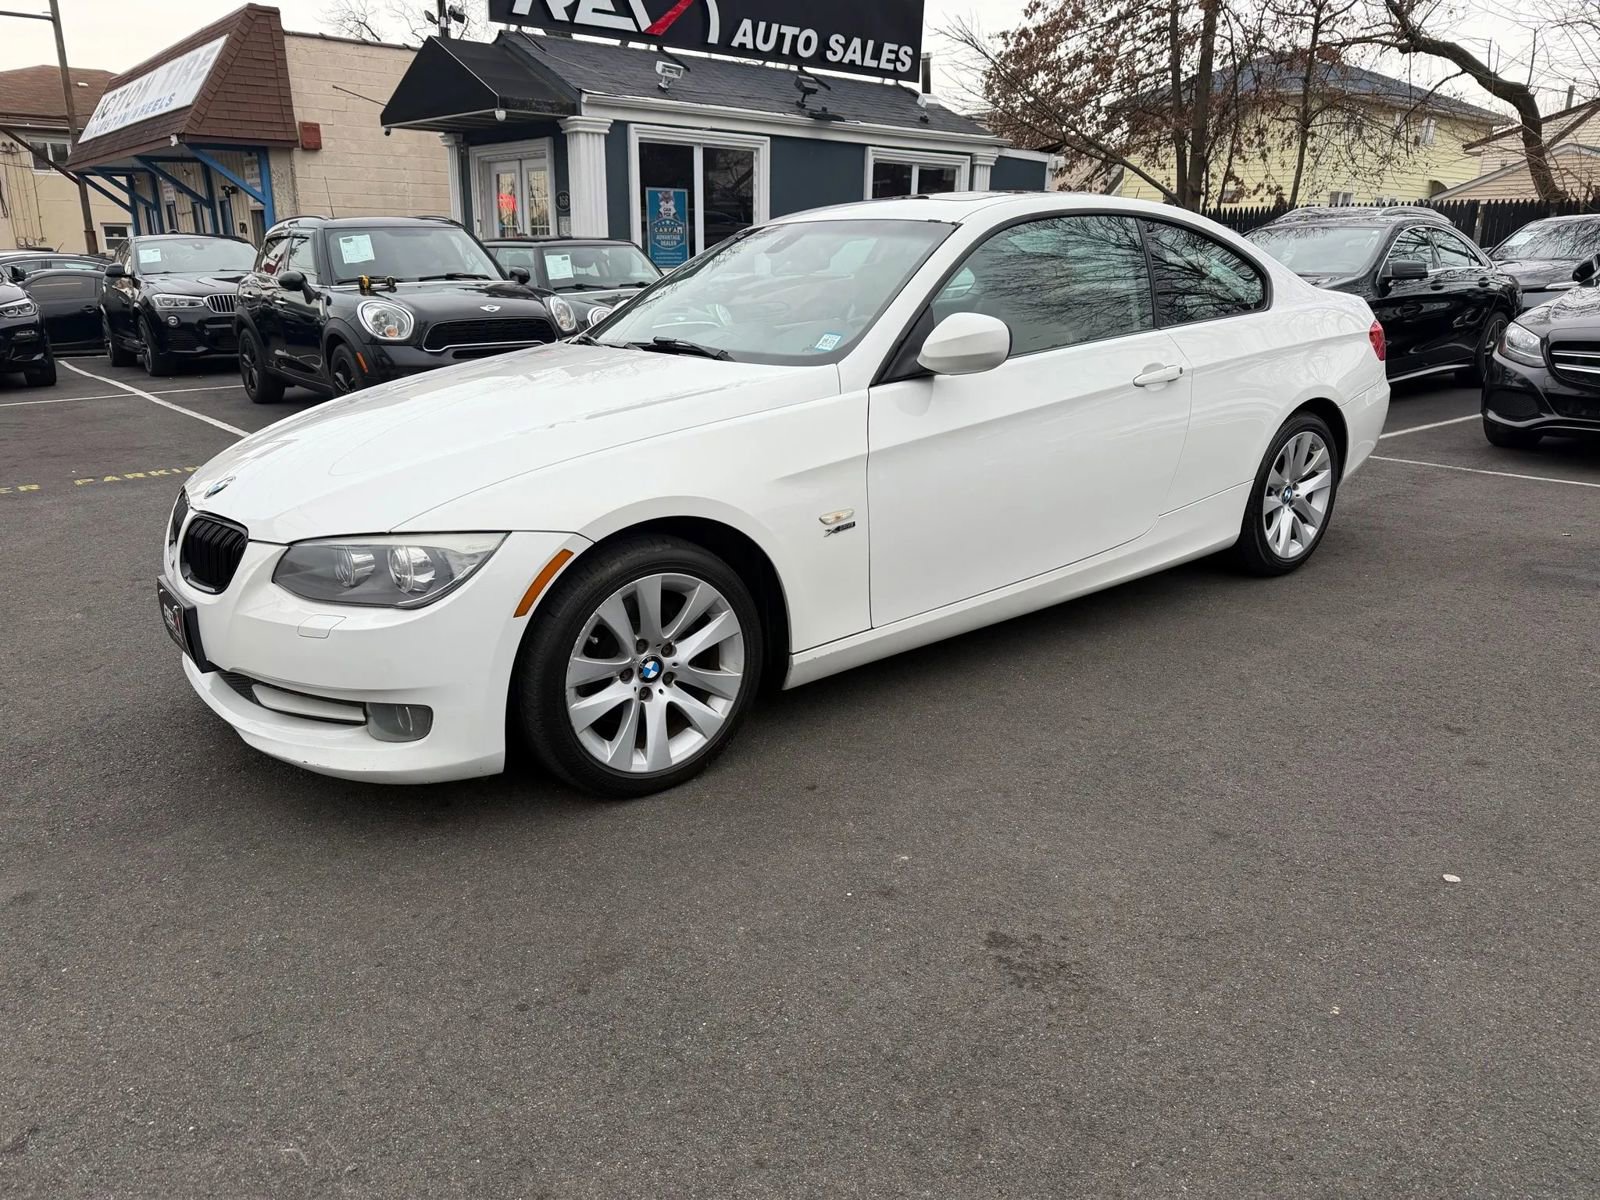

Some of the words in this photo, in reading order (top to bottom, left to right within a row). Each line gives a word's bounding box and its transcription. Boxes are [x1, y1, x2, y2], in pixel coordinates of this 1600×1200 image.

[730, 18, 818, 58] AUTO
[826, 33, 913, 72] SALES
[91, 75, 156, 121] ACTION
[160, 44, 219, 91] TIRE
[73, 466, 200, 485] PARKIN
